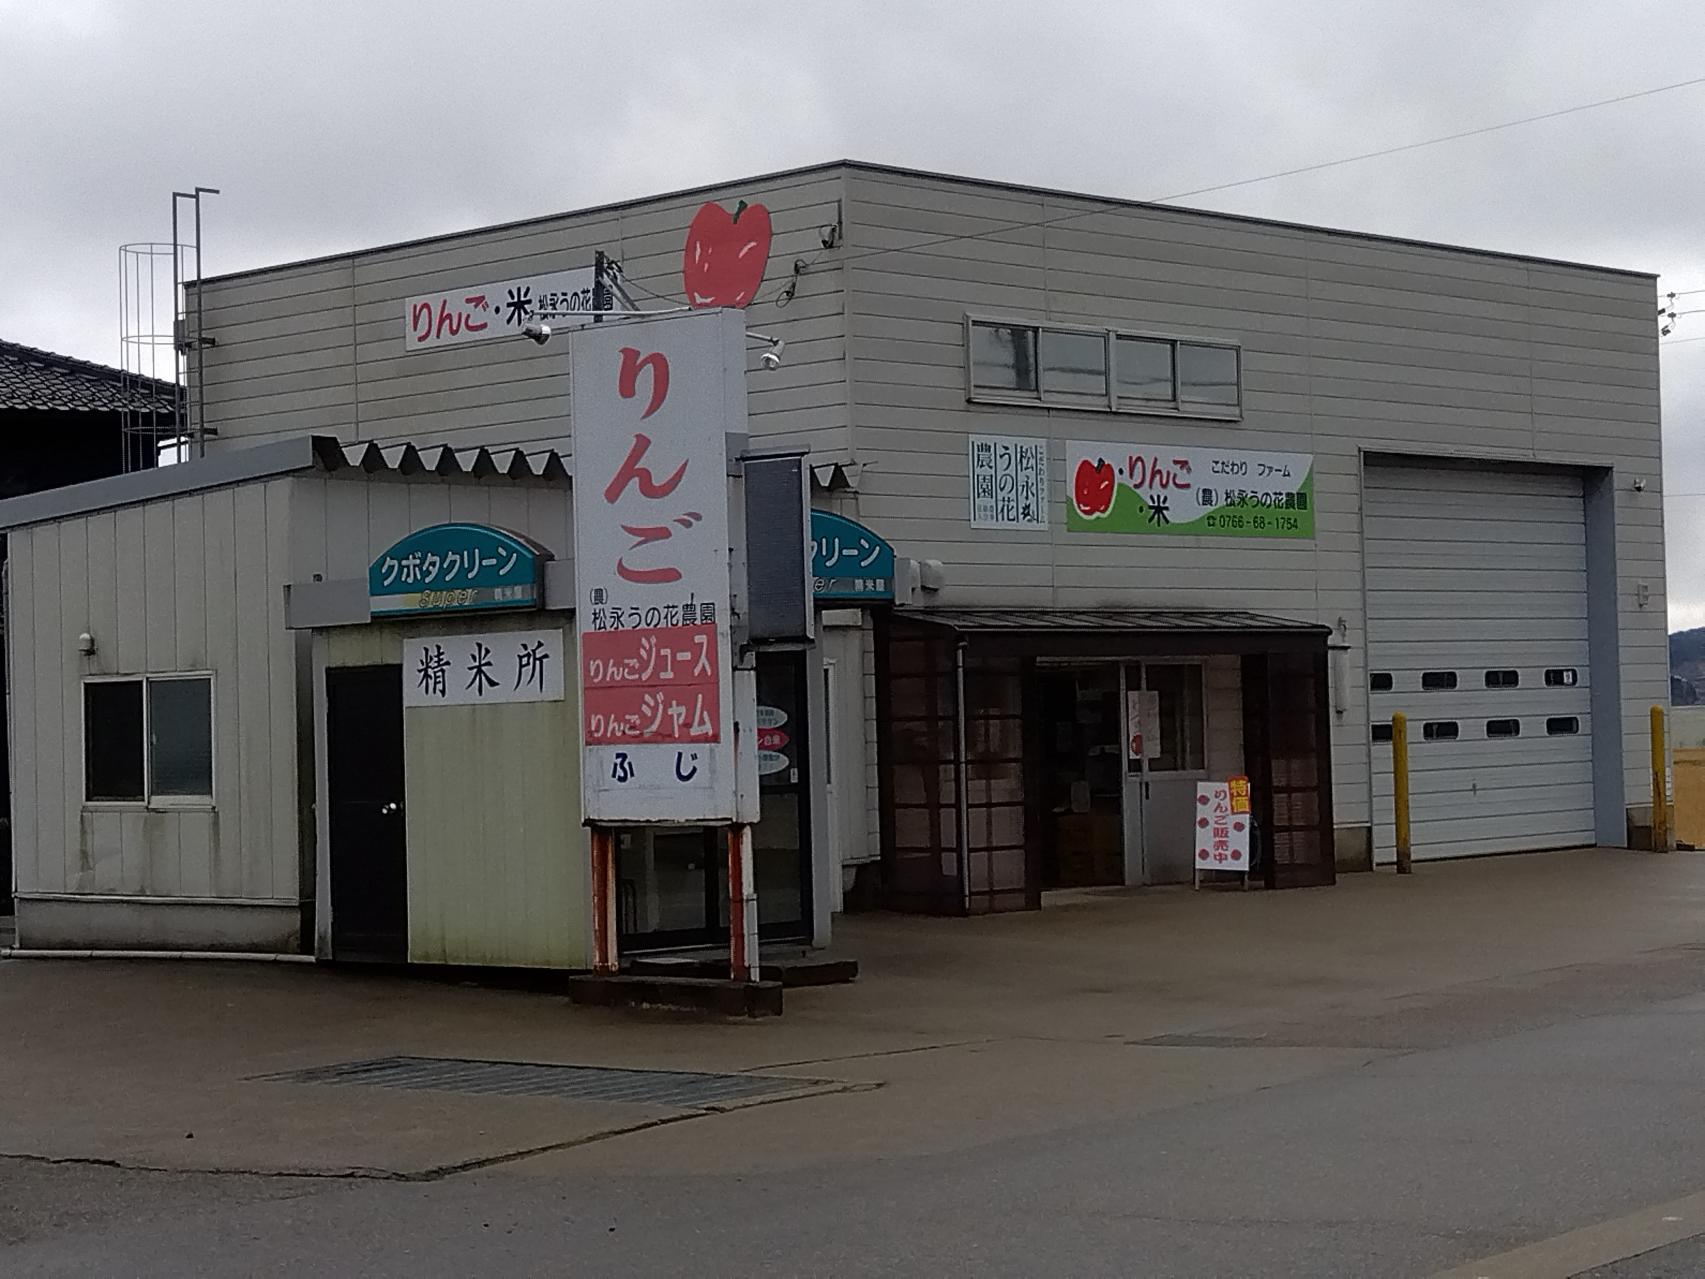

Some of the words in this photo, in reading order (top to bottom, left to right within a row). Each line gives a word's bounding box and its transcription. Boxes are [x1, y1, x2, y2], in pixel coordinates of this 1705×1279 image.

[604, 346, 702, 584] りんご
[999, 445, 1015, 521] うの花
[1019, 446, 1035, 500] 松永
[1212, 460, 1248, 476] こだわり
[1257, 463, 1290, 478] ファーム
[1219, 515, 1298, 530] 0766-68-1754
[381, 546, 517, 587] クボタクリーン
[592, 603, 715, 630] 松永うの花農園
[416, 640, 552, 698] 精米所
[590, 635, 711, 682] りんごジュース
[591, 692, 713, 738] りんごジャム
[1231, 780, 1249, 813] 特価
[1213, 788, 1229, 863] りんご販売中
